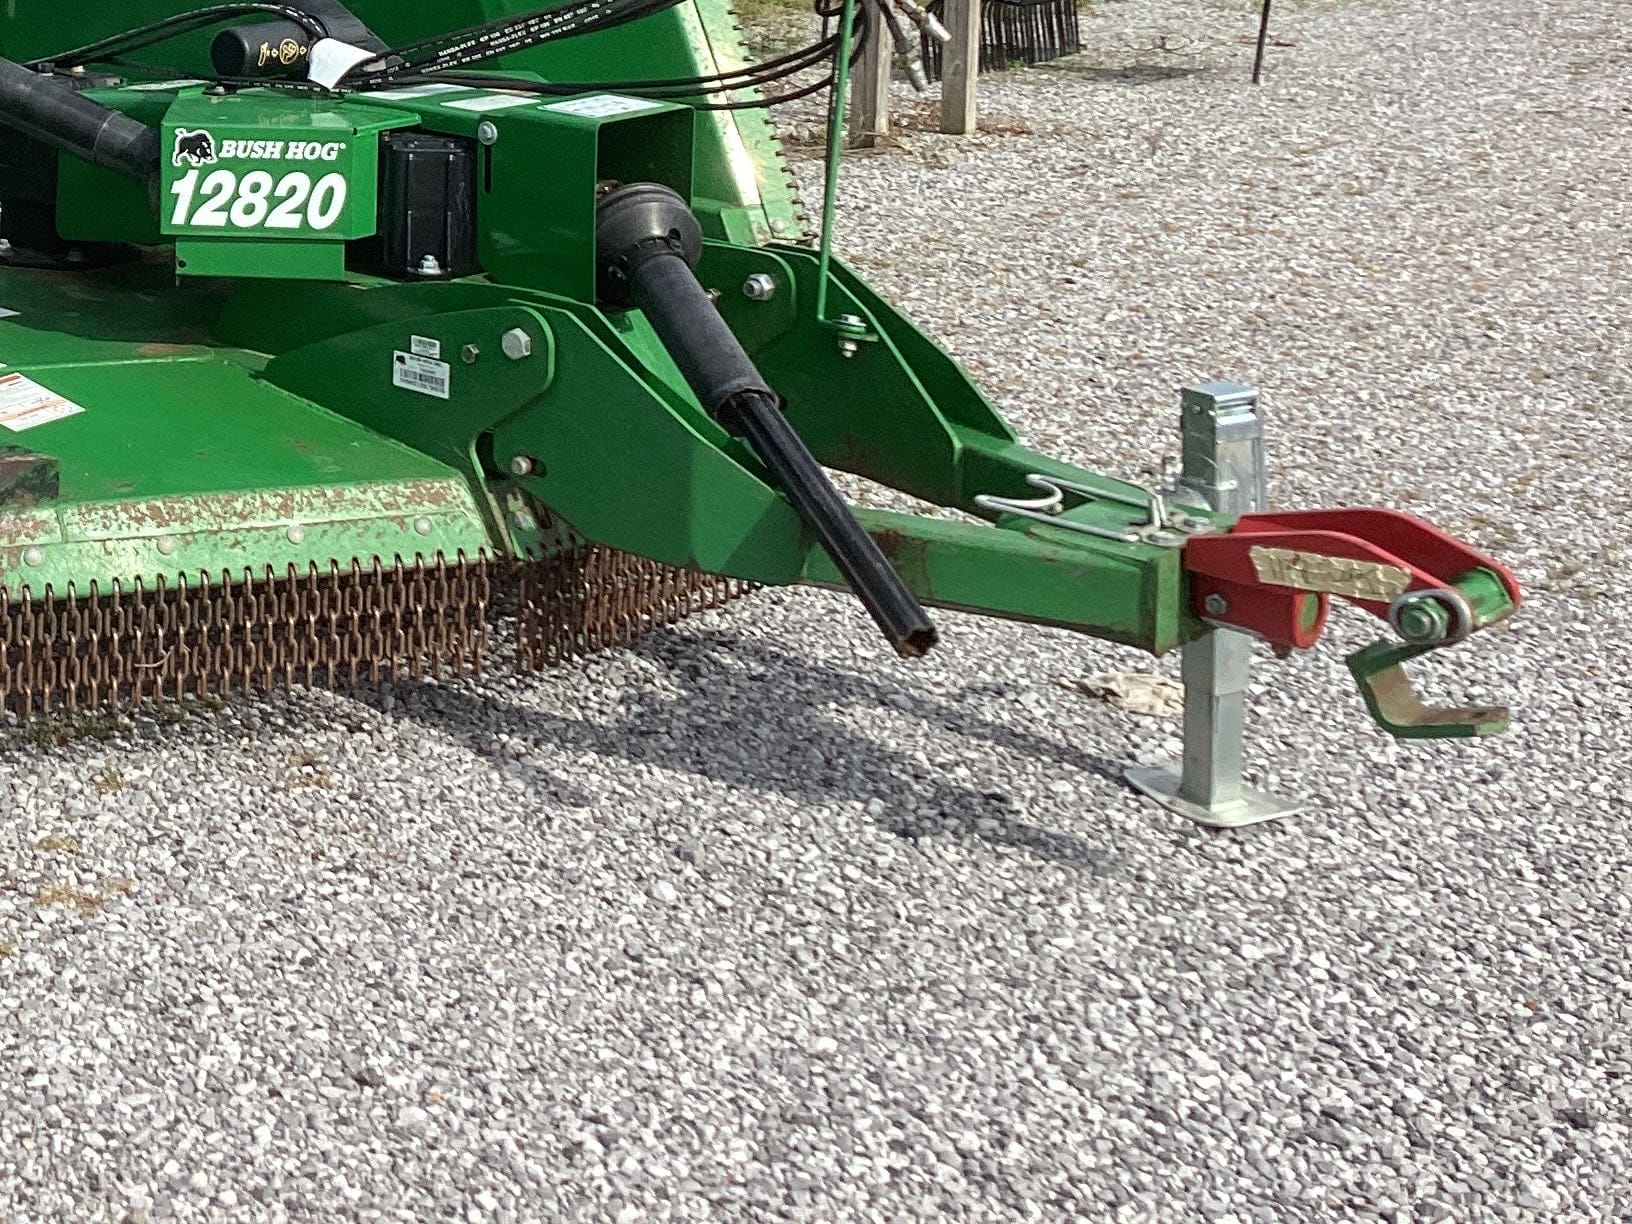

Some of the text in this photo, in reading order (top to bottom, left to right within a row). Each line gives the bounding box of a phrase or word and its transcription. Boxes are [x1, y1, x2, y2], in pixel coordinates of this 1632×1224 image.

[218, 139, 339, 161] BUSH HOG
[170, 168, 347, 230] 12820
